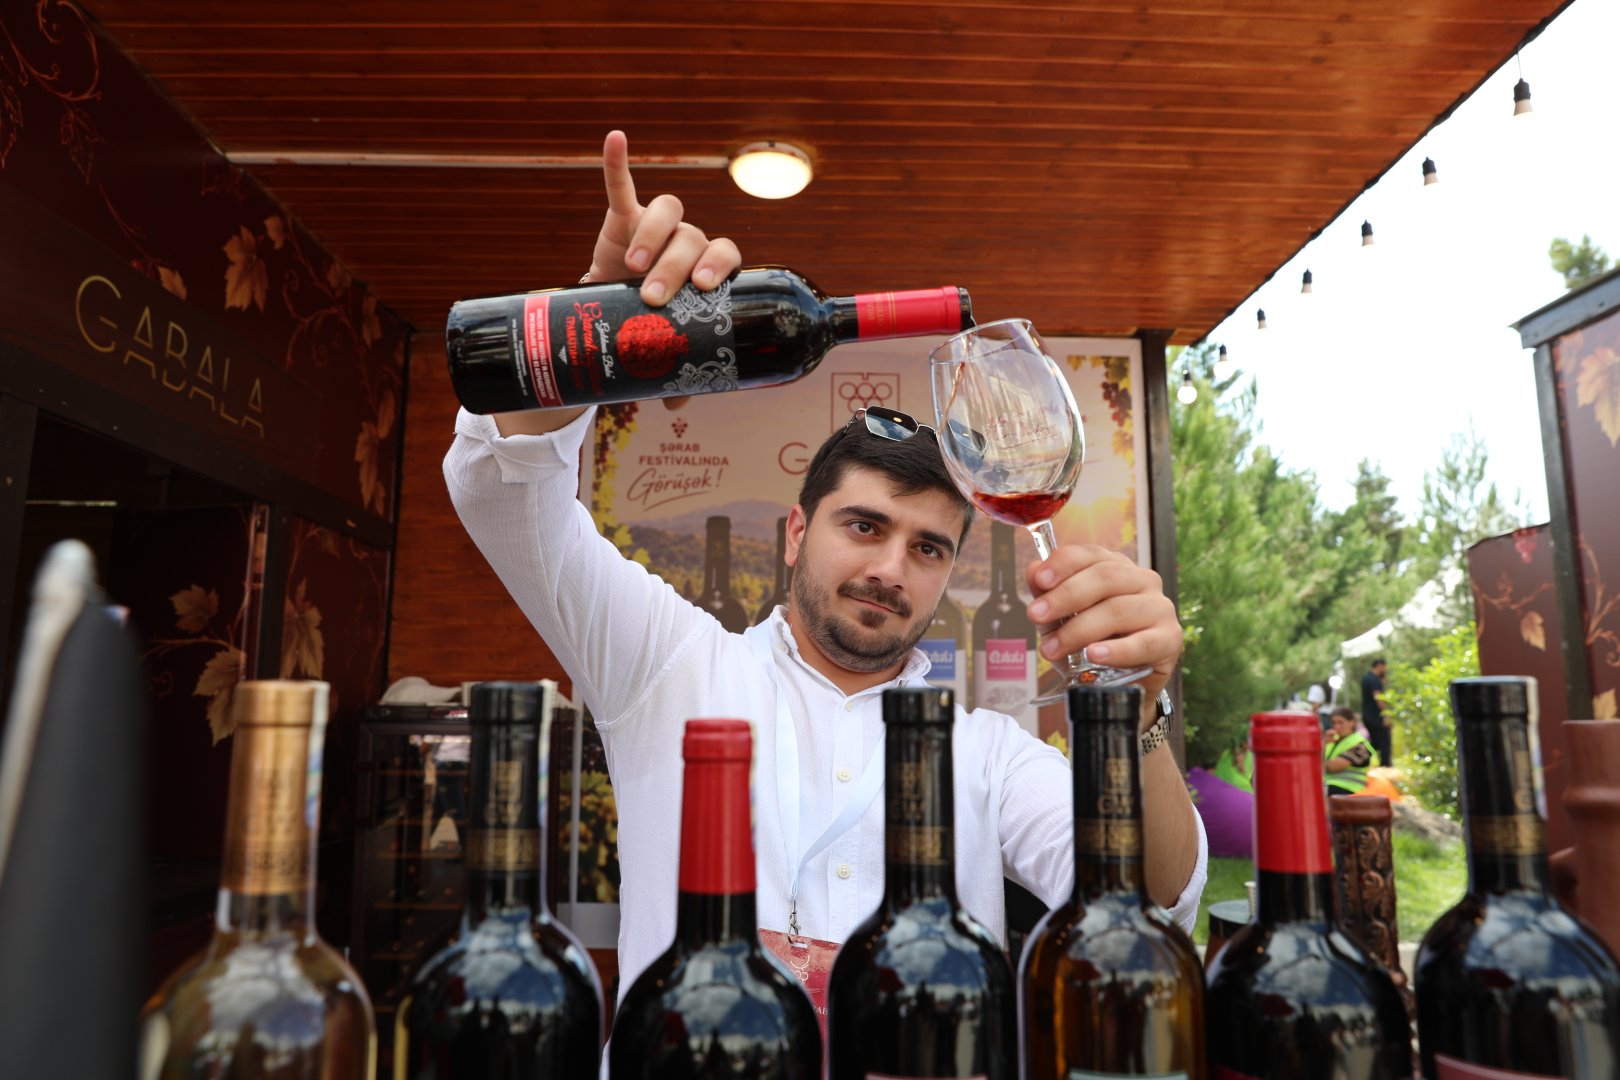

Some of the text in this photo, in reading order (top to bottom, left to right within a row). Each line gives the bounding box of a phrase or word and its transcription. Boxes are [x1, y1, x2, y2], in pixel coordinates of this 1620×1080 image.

[76, 275, 264, 438] GABALA
[660, 443, 701, 453] ŞƏRAB
[639, 454, 729, 466] FESTİVALINDA
